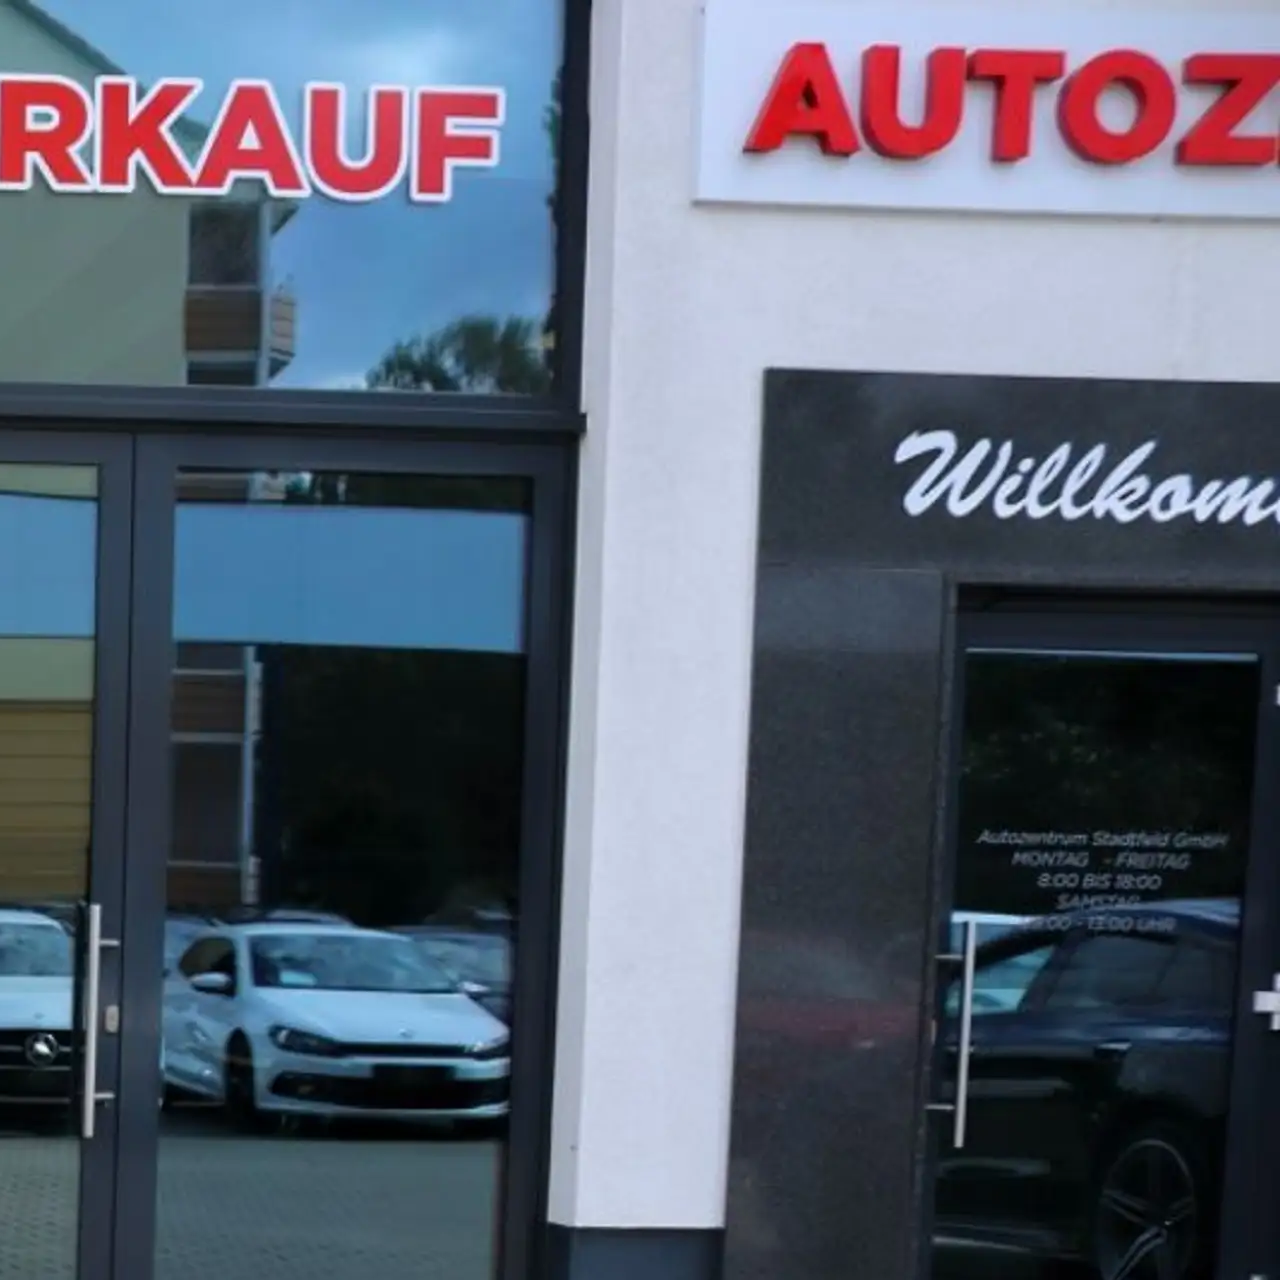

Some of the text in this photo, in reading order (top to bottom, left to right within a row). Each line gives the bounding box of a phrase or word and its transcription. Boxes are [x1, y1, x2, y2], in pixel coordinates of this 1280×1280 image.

[743, 41, 1280, 170] AUTOZ
[894, 429, 1280, 526] Willkom
[1011, 851, 1090, 868] MONTAG
